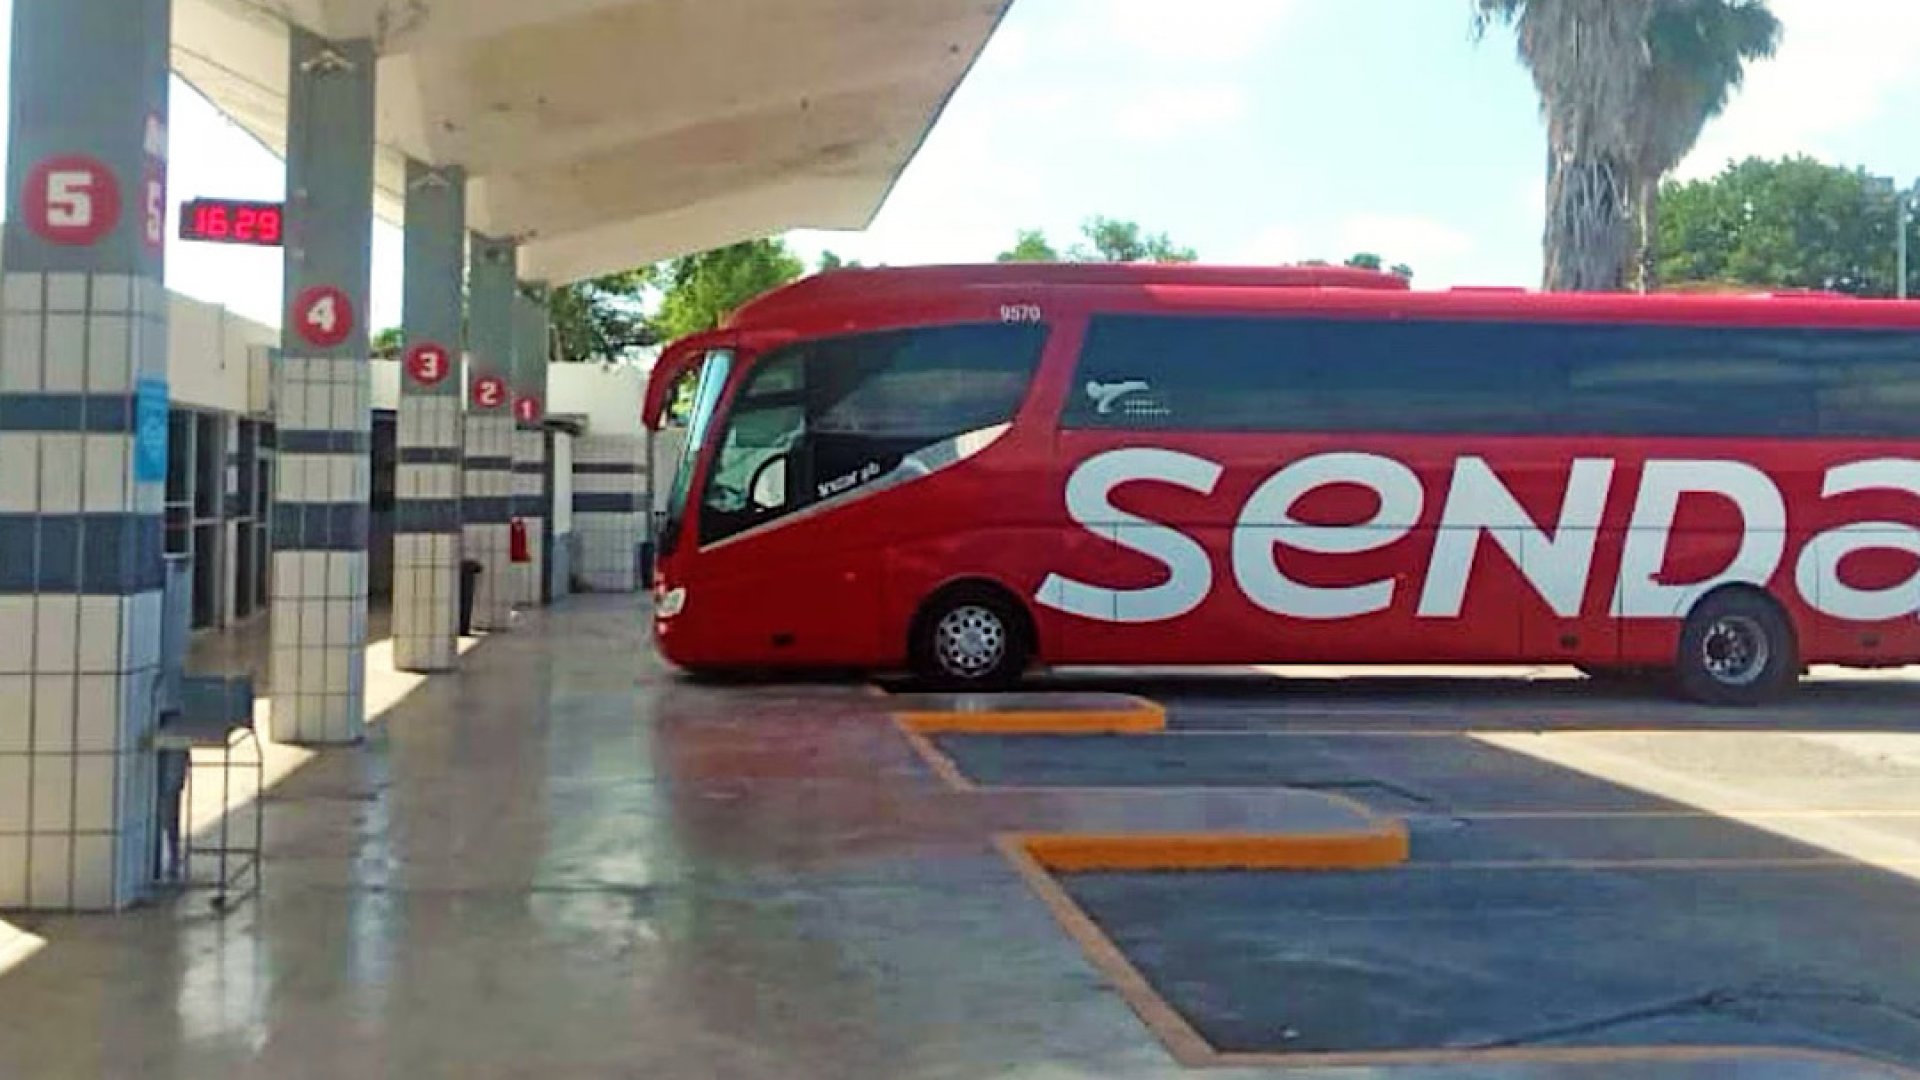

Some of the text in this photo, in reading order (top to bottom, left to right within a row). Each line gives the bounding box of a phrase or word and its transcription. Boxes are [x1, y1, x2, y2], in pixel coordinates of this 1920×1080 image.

[46, 171, 92, 226] 5
[308, 297, 334, 331] 4
[420, 352, 438, 378] 3
[480, 381, 497, 405] 2
[521, 400, 531, 419] 1
